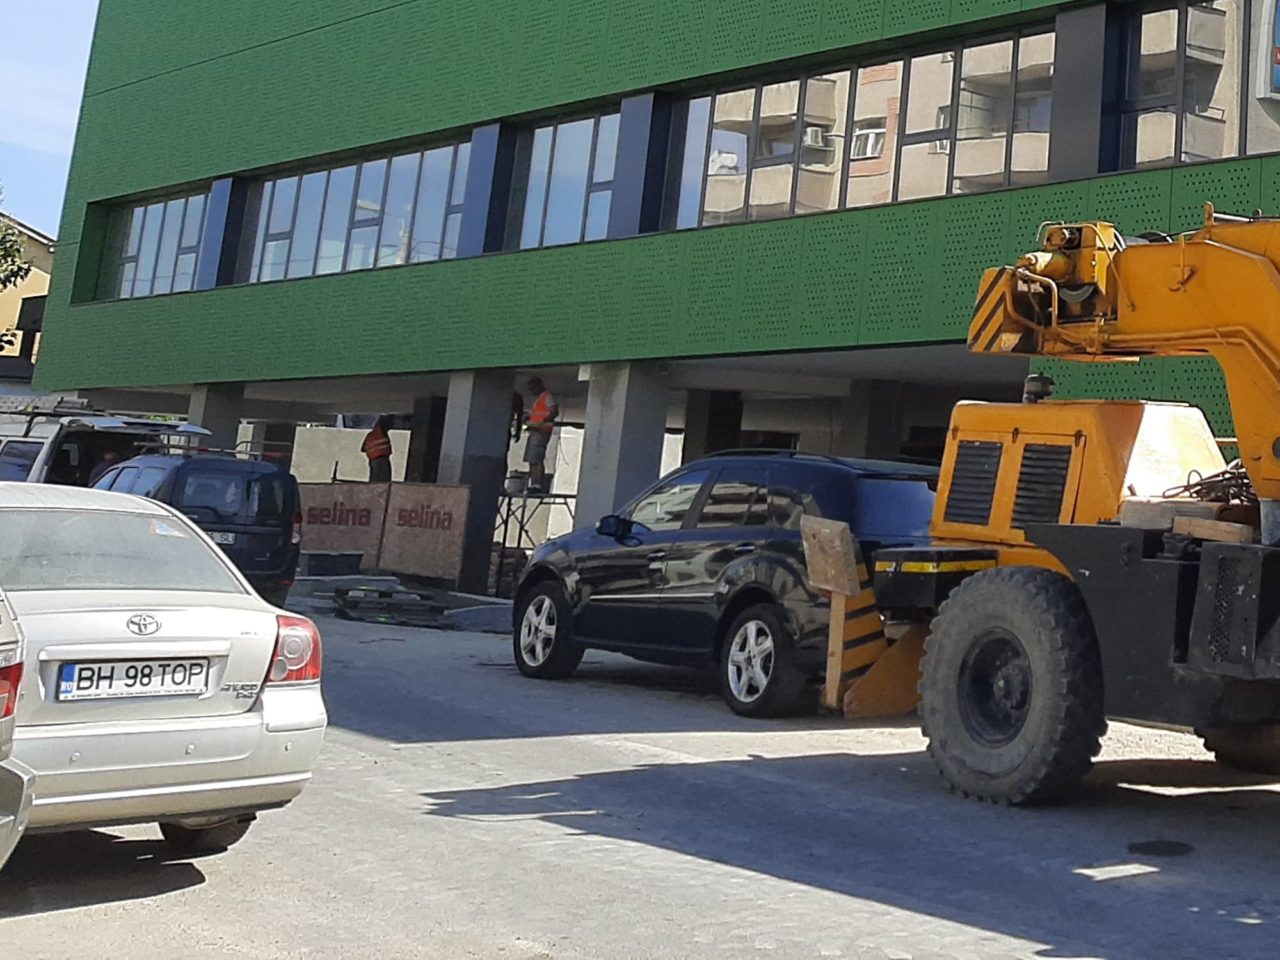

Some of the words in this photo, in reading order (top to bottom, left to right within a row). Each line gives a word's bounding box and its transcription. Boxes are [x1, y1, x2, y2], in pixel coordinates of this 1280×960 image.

[306, 502, 371, 526] selina
[397, 504, 452, 530] selina
[76, 666, 115, 691] BH
[124, 665, 153, 688] 98
[158, 663, 203, 687] TOP
